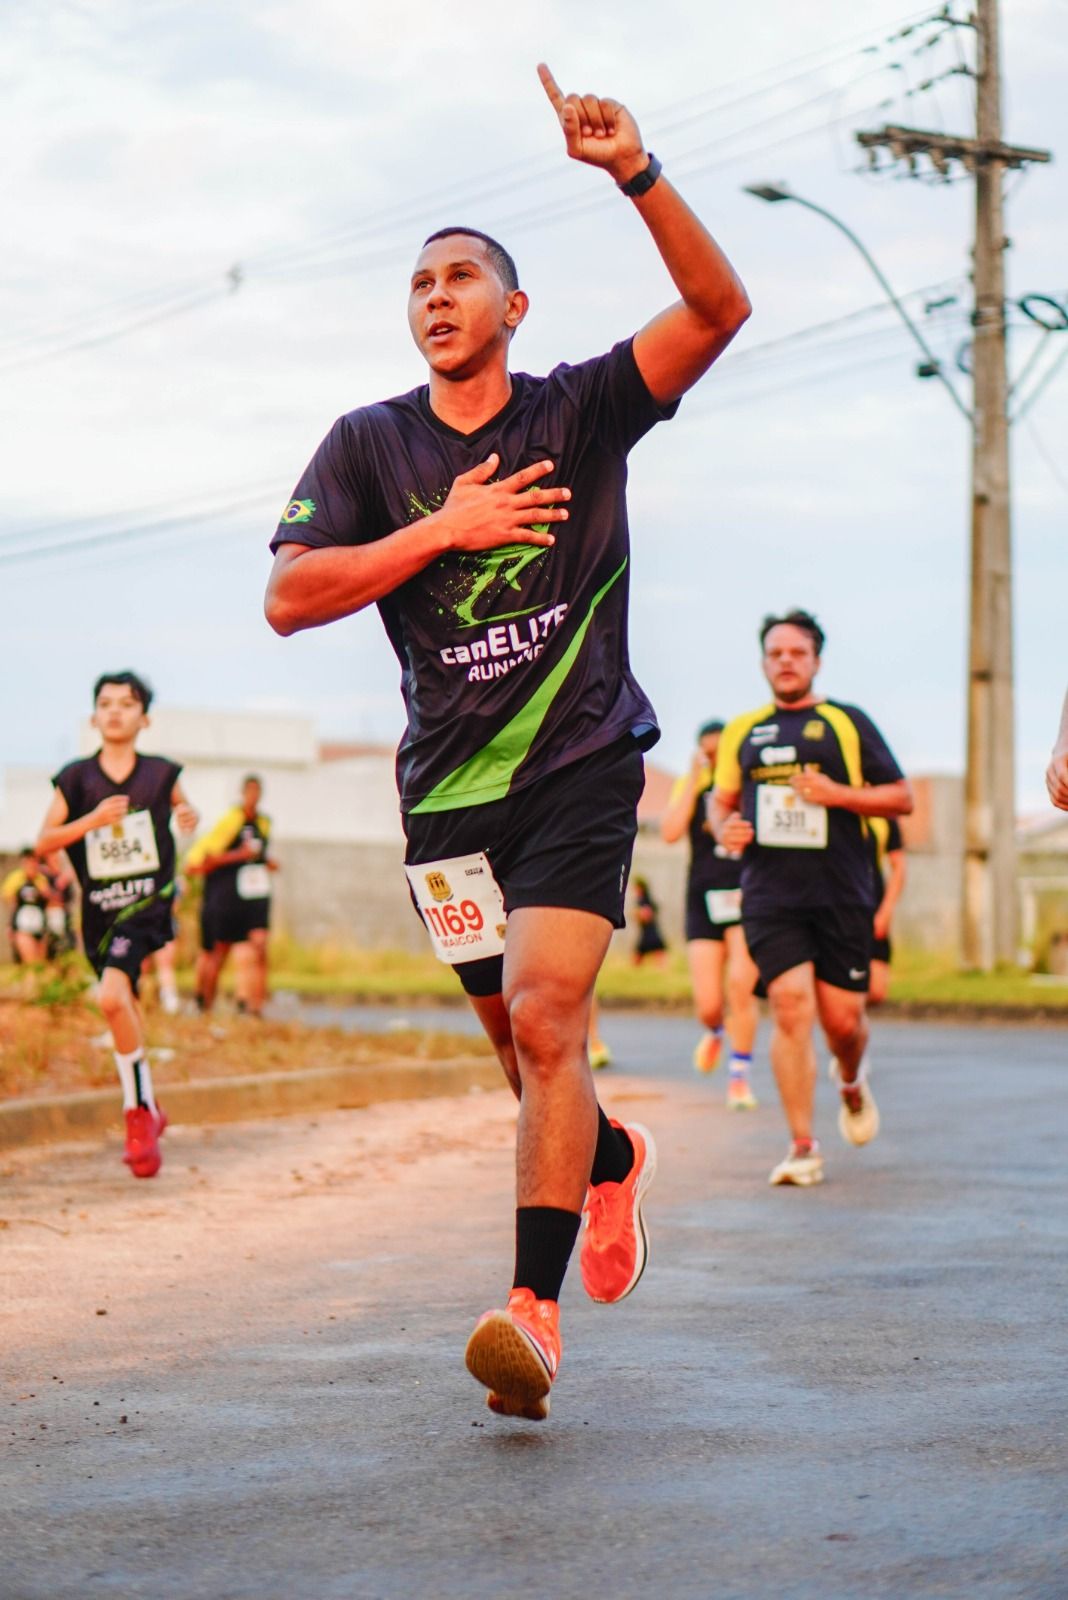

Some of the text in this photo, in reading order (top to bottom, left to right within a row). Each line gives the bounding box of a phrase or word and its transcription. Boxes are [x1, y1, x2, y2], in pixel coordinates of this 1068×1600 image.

[100, 839, 142, 861] 5854
[424, 899, 484, 938] 1169
[440, 933, 484, 949] MAICON
